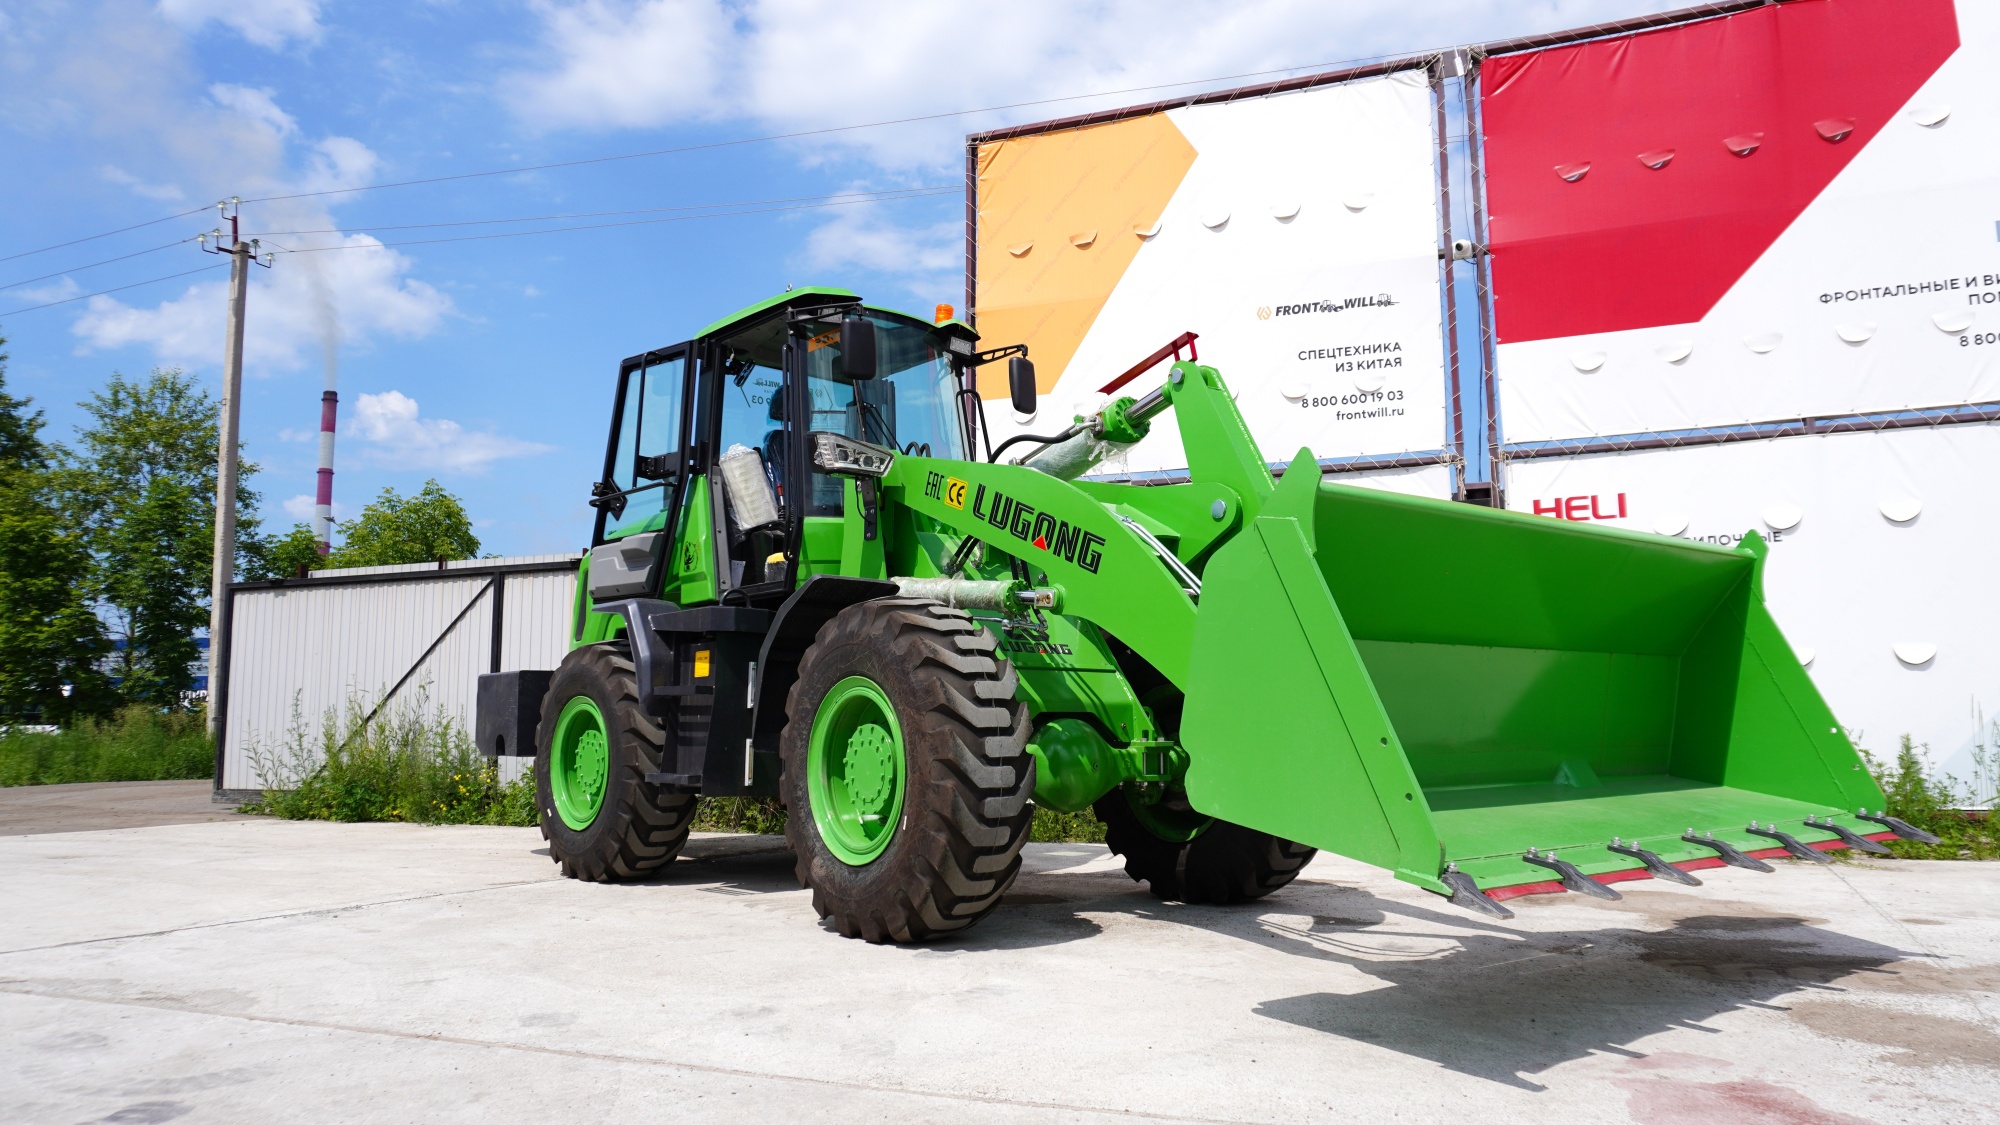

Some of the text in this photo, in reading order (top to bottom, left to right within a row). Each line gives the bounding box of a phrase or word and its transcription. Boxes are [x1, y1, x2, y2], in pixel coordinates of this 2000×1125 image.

[1819, 278, 1960, 304] ФРОНТАЛЬНЫЕ
[1965, 276, 1978, 288] И
[1968, 291, 2000, 305] ПО
[1275, 296, 1376, 317] FRONT WILL
[1959, 333, 2000, 347] 8 80
[1298, 342, 1402, 361] СПЕЦТЕХНИКА
[1335, 357, 1402, 373] ИЗ КИТАЯ
[1301, 390, 1404, 408] 8 800 600 19 03
[1336, 407, 1404, 421] frontwill.ru
[1533, 493, 1628, 522] HELI
[972, 483, 1106, 575] LUGONG
